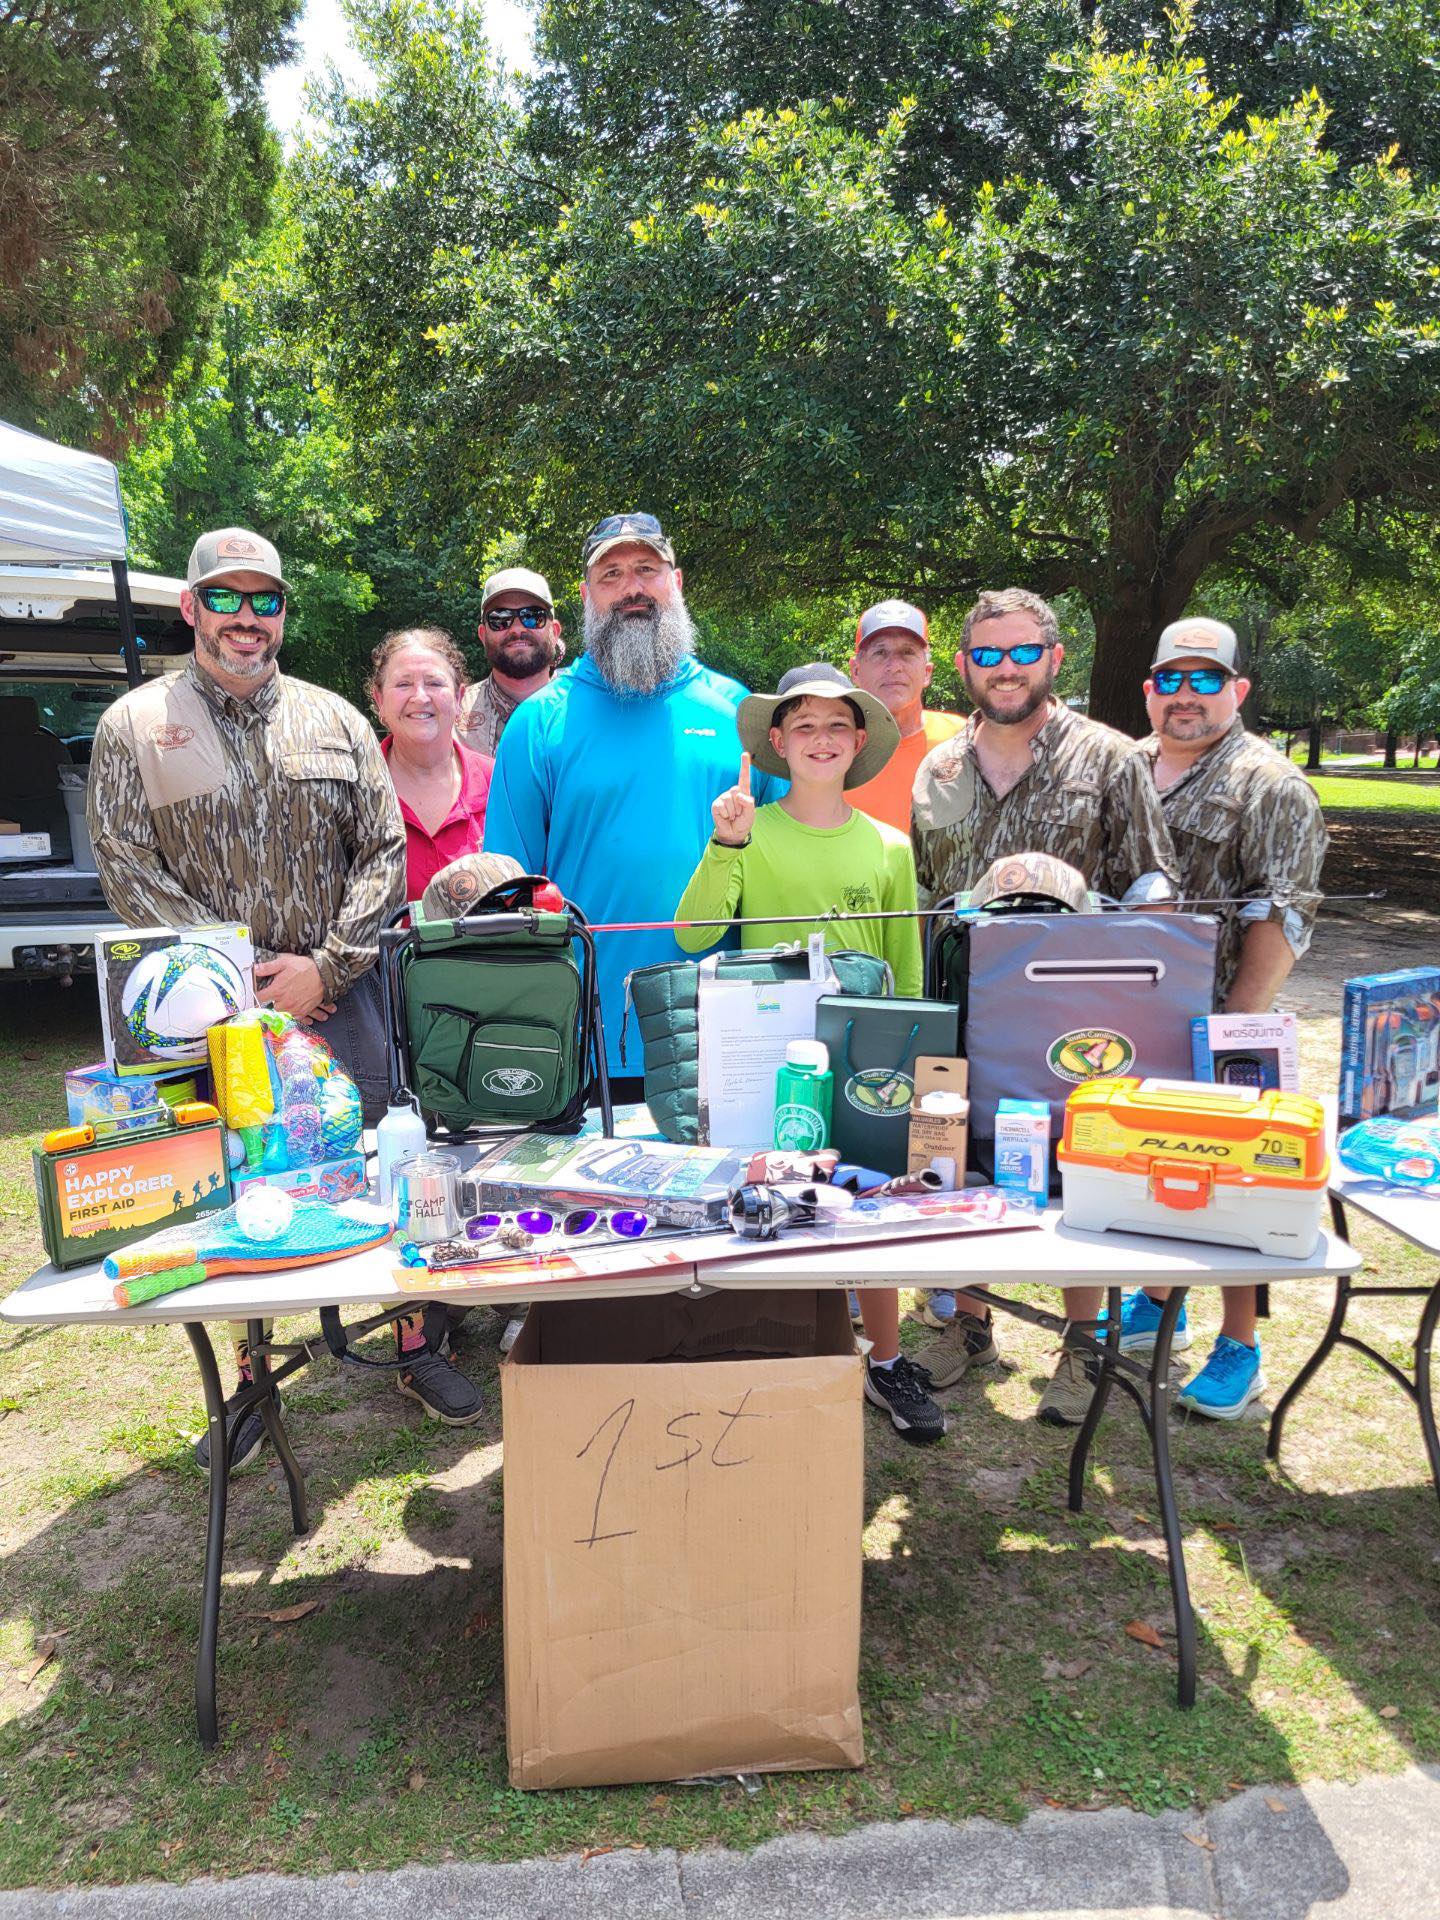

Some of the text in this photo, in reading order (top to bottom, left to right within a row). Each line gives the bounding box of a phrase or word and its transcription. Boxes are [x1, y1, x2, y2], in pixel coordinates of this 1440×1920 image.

[112, 953, 142, 961] ATHLETIC
[1064, 1030, 1118, 1042] South Carolina
[1222, 1027, 1284, 1039] MOSQUITO
[1348, 1032, 1359, 1067] COLLECTION
[880, 1071, 905, 1083] Carlina
[1053, 1059, 1130, 1081] Waterfowl Association
[850, 1093, 911, 1114] Waterfowl Associati
[912, 1122, 949, 1131] WATERPROOF
[923, 1143, 957, 1152] Outdoor
[1139, 1137, 1231, 1157] PLANO
[1260, 1138, 1283, 1154] 70
[1000, 1151, 1023, 1165] 12
[65, 1165, 135, 1193] HAPPY
[67, 1173, 174, 1209] EXPLORER
[415, 1196, 446, 1208] CAMP
[69, 1203, 108, 1221] FIRST
[112, 1198, 135, 1212] AID
[416, 1207, 444, 1218] HALL
[574, 1388, 768, 1548] 1st
